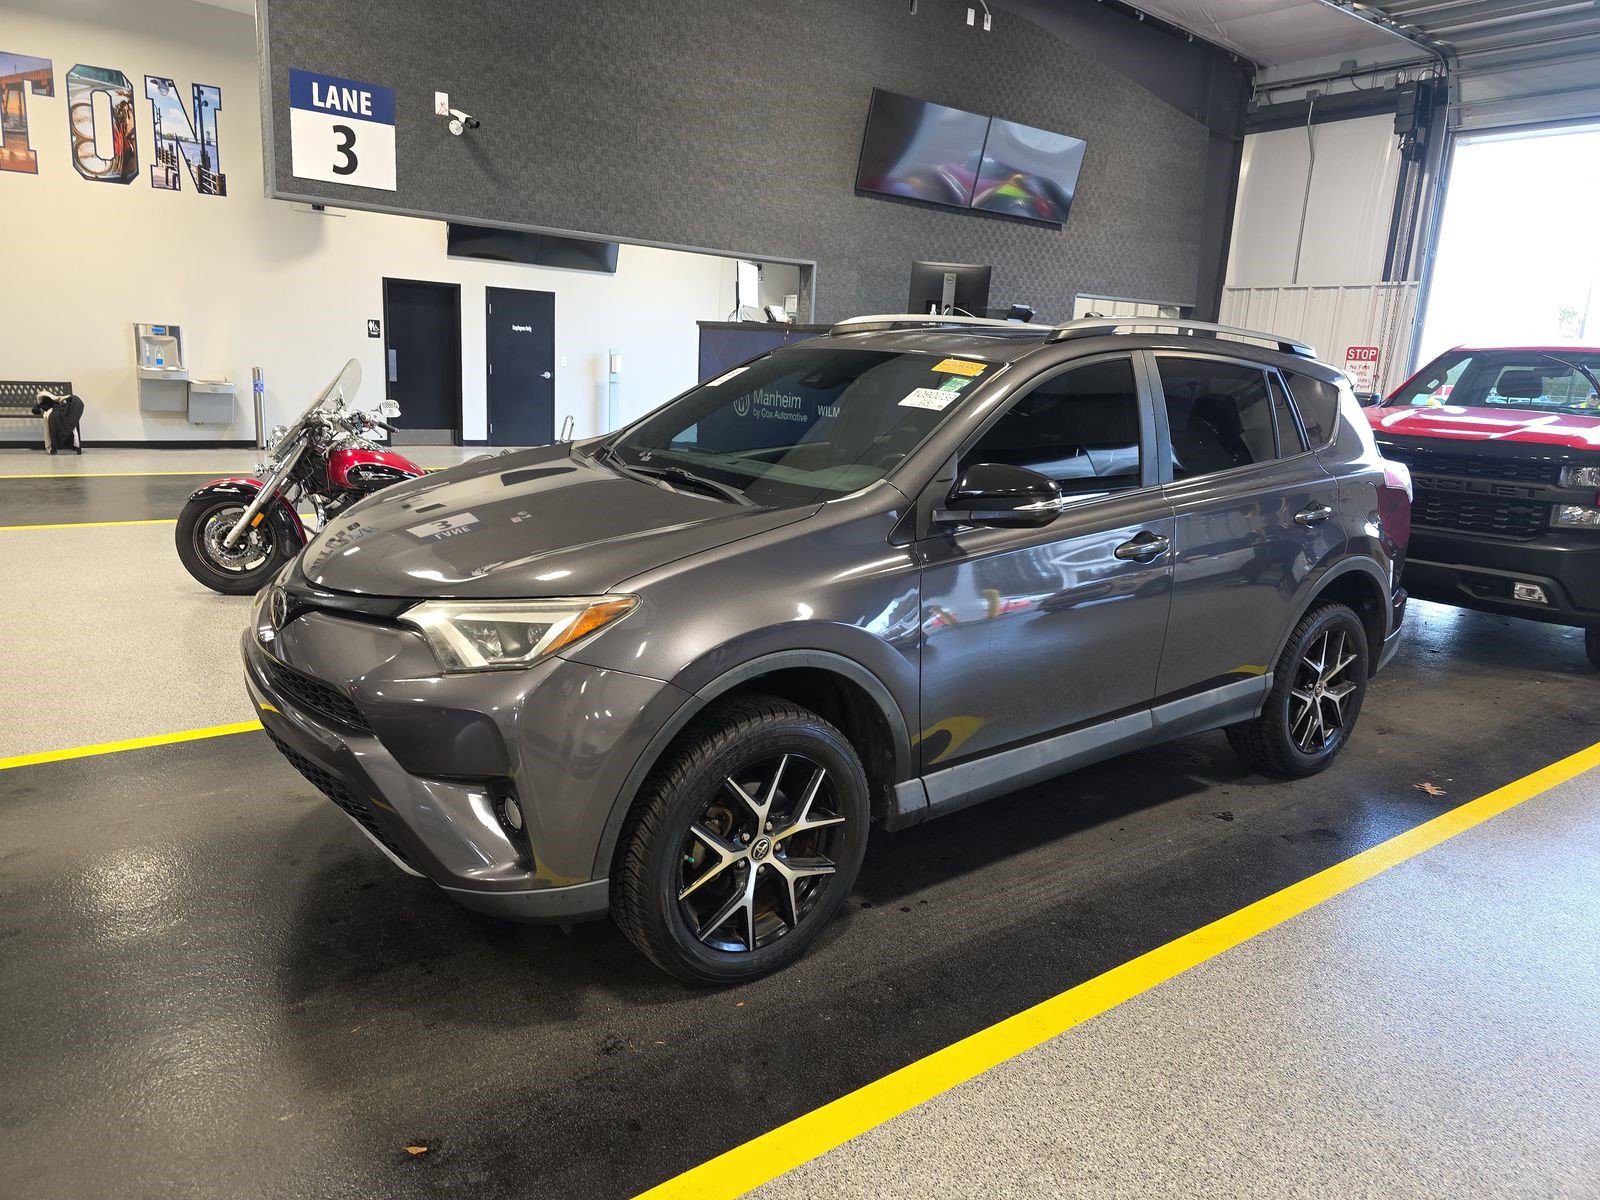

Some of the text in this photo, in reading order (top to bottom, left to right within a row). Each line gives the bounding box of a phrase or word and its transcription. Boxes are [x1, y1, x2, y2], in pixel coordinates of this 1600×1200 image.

[312, 81, 373, 116] LANE
[332, 124, 359, 176] 3
[1347, 348, 1377, 360] STOP
[753, 388, 802, 409] Manheim
[752, 407, 808, 423] by Cox Automotive
